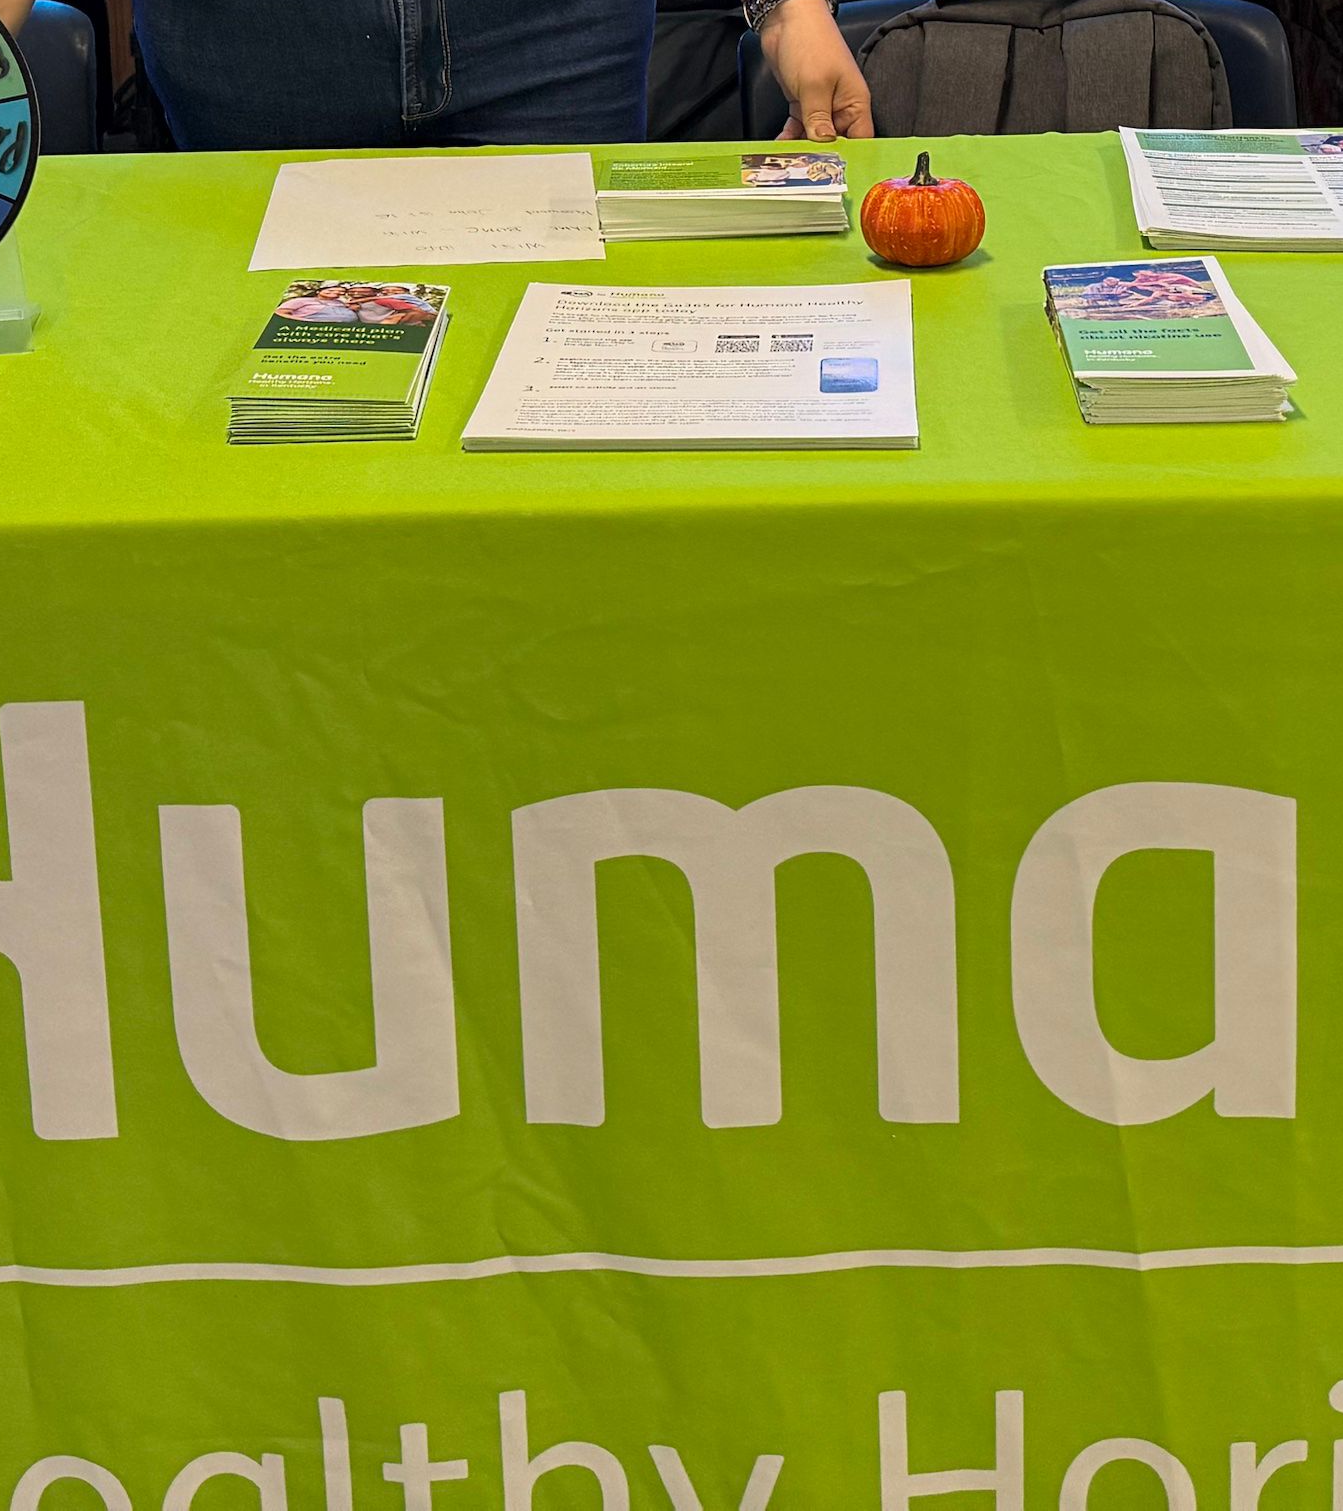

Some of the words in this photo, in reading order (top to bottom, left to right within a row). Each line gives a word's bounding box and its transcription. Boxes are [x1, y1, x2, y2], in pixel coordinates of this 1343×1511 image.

[369, 327, 405, 335] plan
[272, 337, 328, 345] always
[252, 372, 333, 381] Humana
